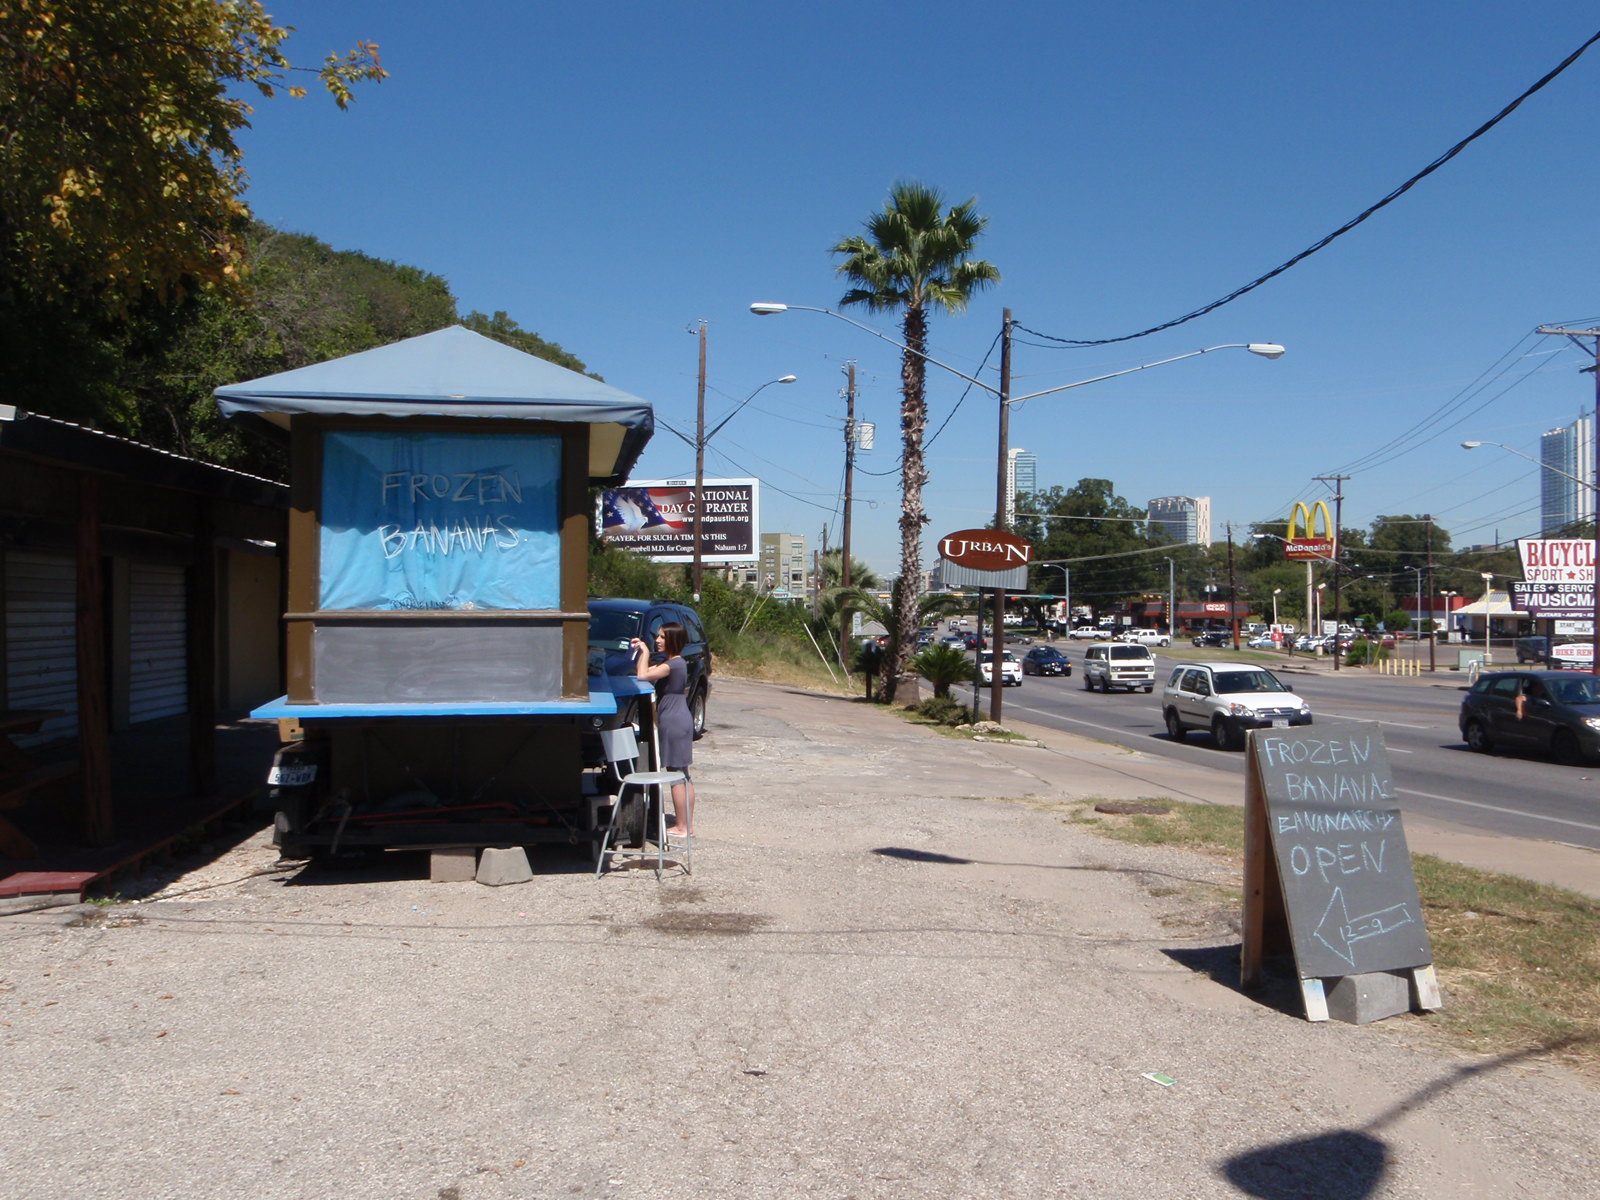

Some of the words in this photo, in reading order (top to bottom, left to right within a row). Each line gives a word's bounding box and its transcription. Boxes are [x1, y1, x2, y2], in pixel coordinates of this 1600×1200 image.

[382, 470, 523, 506] FROZEN
[662, 503, 683, 514] DAY
[706, 503, 748, 513] PRAYER
[378, 514, 520, 559] BANANAS
[680, 533, 694, 541] TIM
[666, 544, 675, 552] for
[675, 544, 695, 553] Congr
[1285, 544, 1332, 552] McDonald's
[1527, 568, 1564, 581] SPORT
[1514, 584, 1546, 593] SALES
[1555, 648, 1574, 656] BIKE
[1264, 736, 1370, 767] FROZEN
[1290, 839, 1386, 883] OPEN
